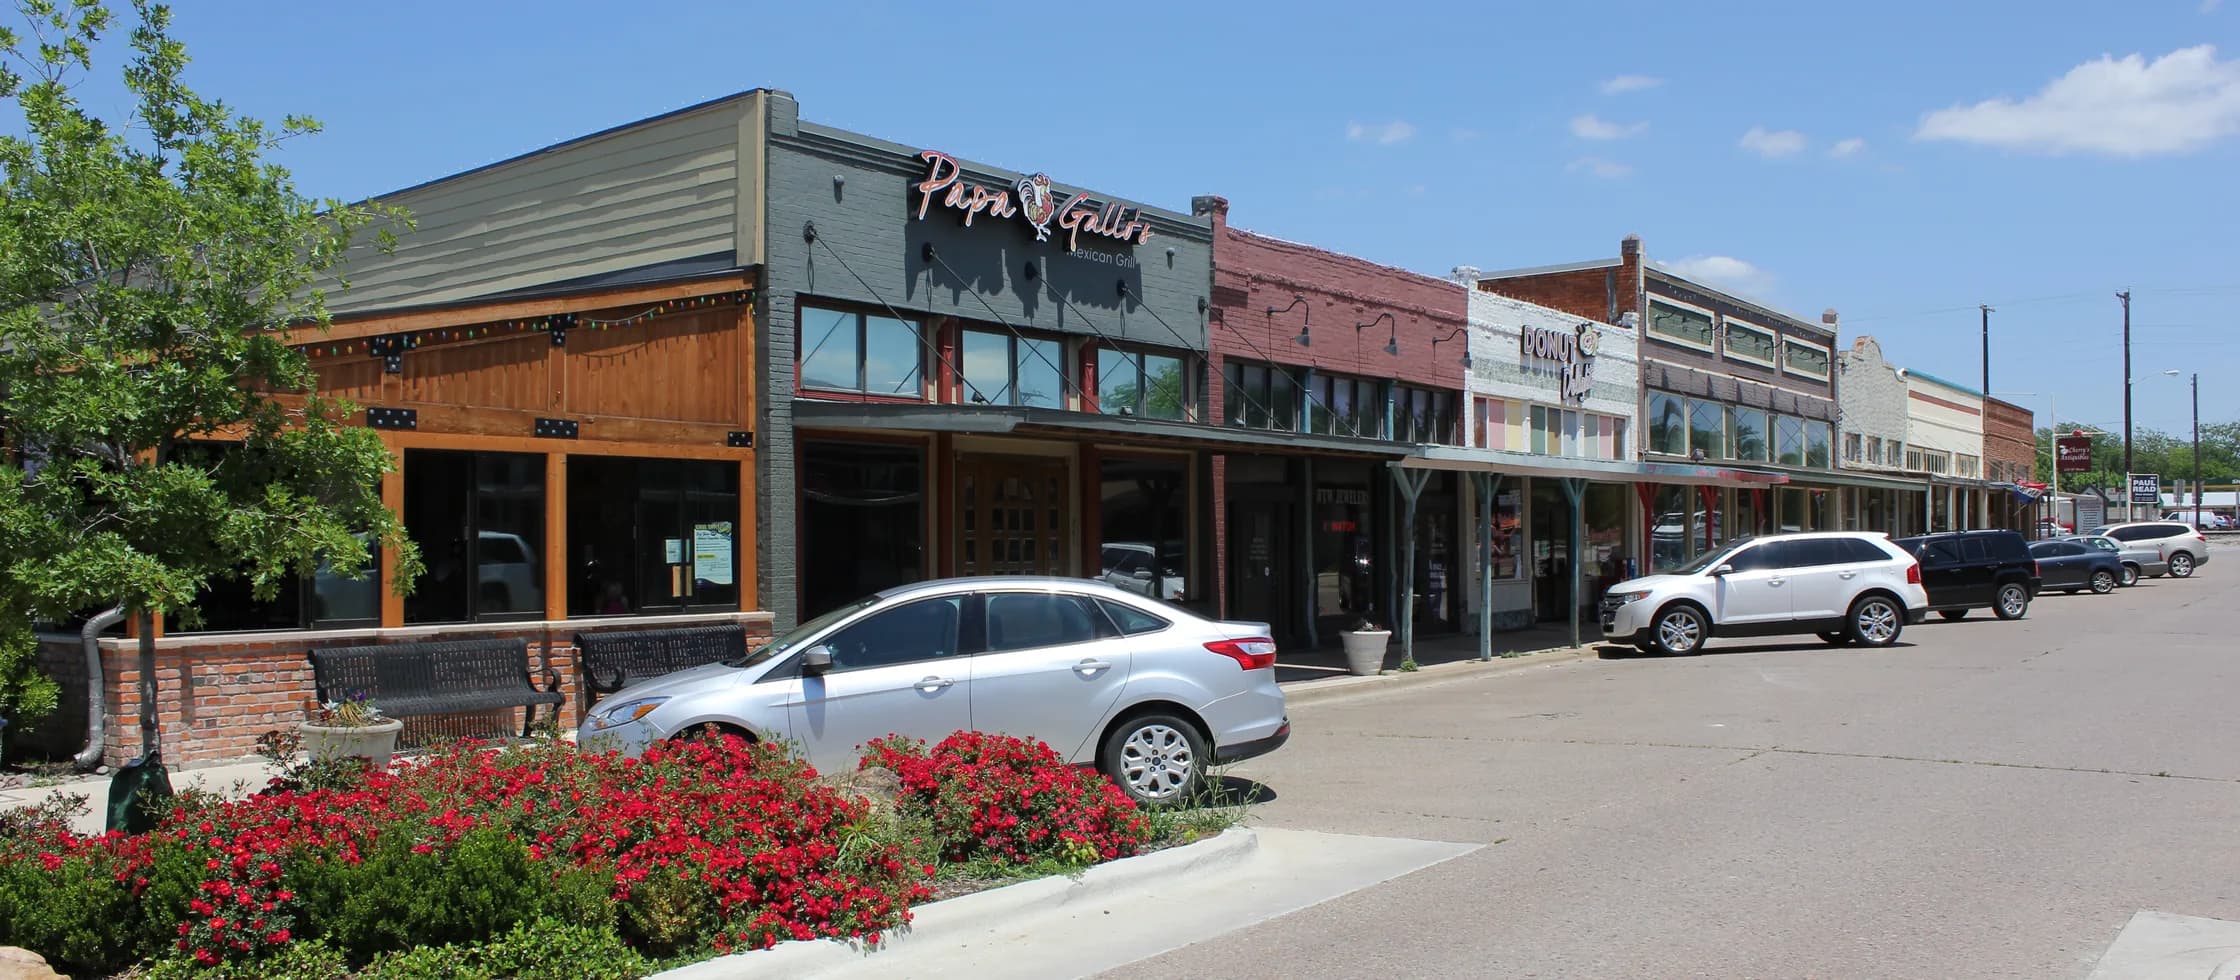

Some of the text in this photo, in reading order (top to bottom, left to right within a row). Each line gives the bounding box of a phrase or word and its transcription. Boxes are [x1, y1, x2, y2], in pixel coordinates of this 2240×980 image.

[919, 150, 1155, 252] Papa Gallo's
[1115, 253, 1137, 270] Grill
[1522, 325, 1577, 365] DONUT
